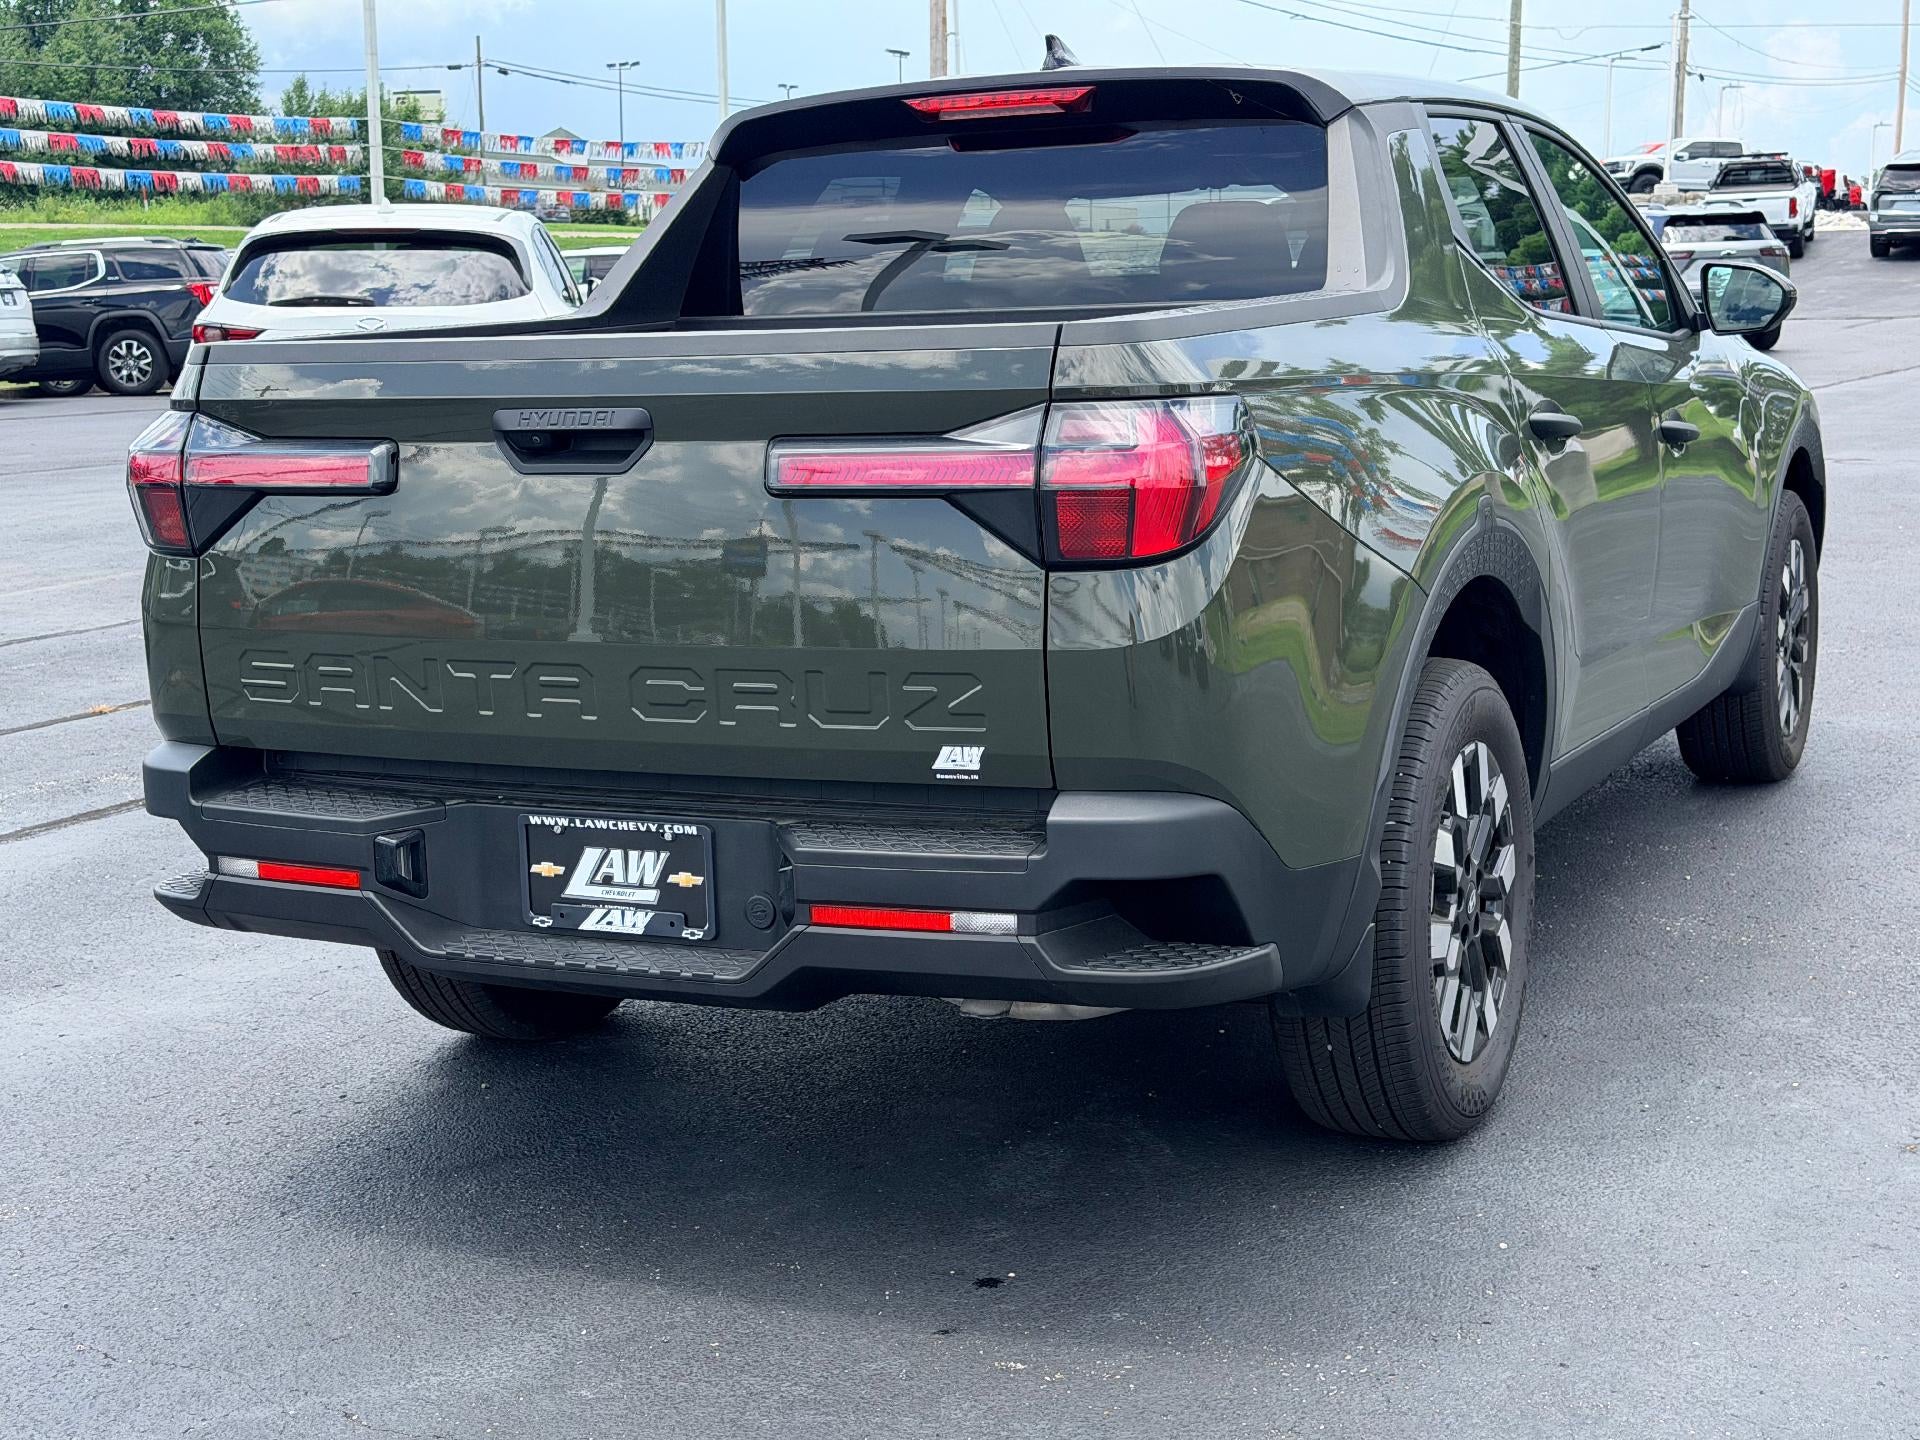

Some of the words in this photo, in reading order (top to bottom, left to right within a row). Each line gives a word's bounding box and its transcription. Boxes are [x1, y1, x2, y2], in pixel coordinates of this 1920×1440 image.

[518, 410, 616, 428] HYUNDAI
[239, 649, 598, 720] SANTA
[629, 666, 987, 732] CRUZ
[931, 745, 985, 770] LAW
[528, 815, 698, 836] WWW.LAWCHEVY.COM
[561, 846, 670, 905] LAW
[600, 889, 636, 898] CHEVROLET
[577, 908, 656, 935] LAW
